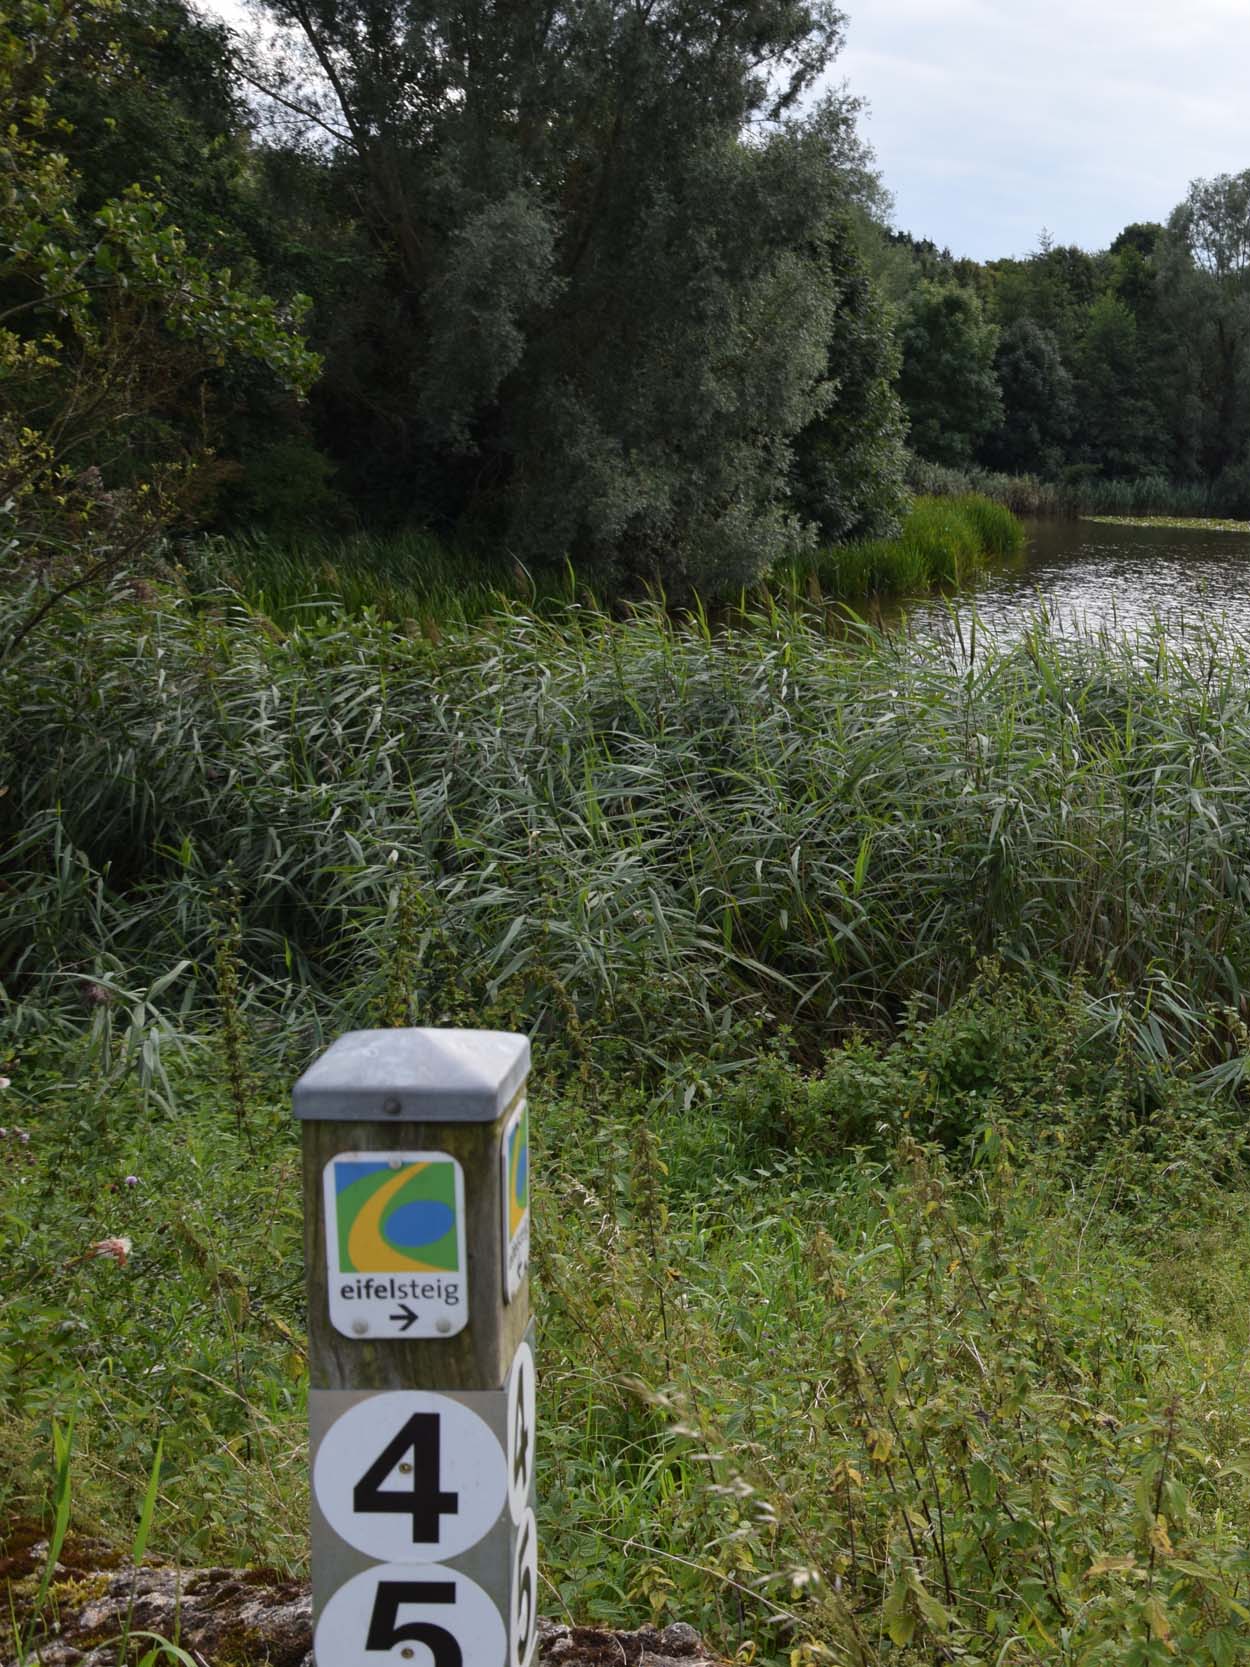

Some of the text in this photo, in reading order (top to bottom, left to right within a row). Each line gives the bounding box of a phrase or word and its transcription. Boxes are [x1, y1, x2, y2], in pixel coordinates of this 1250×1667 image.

[340, 1278, 459, 1305] eifelsteig
[353, 1412, 459, 1543] 4
[365, 1581, 463, 1667] 5
